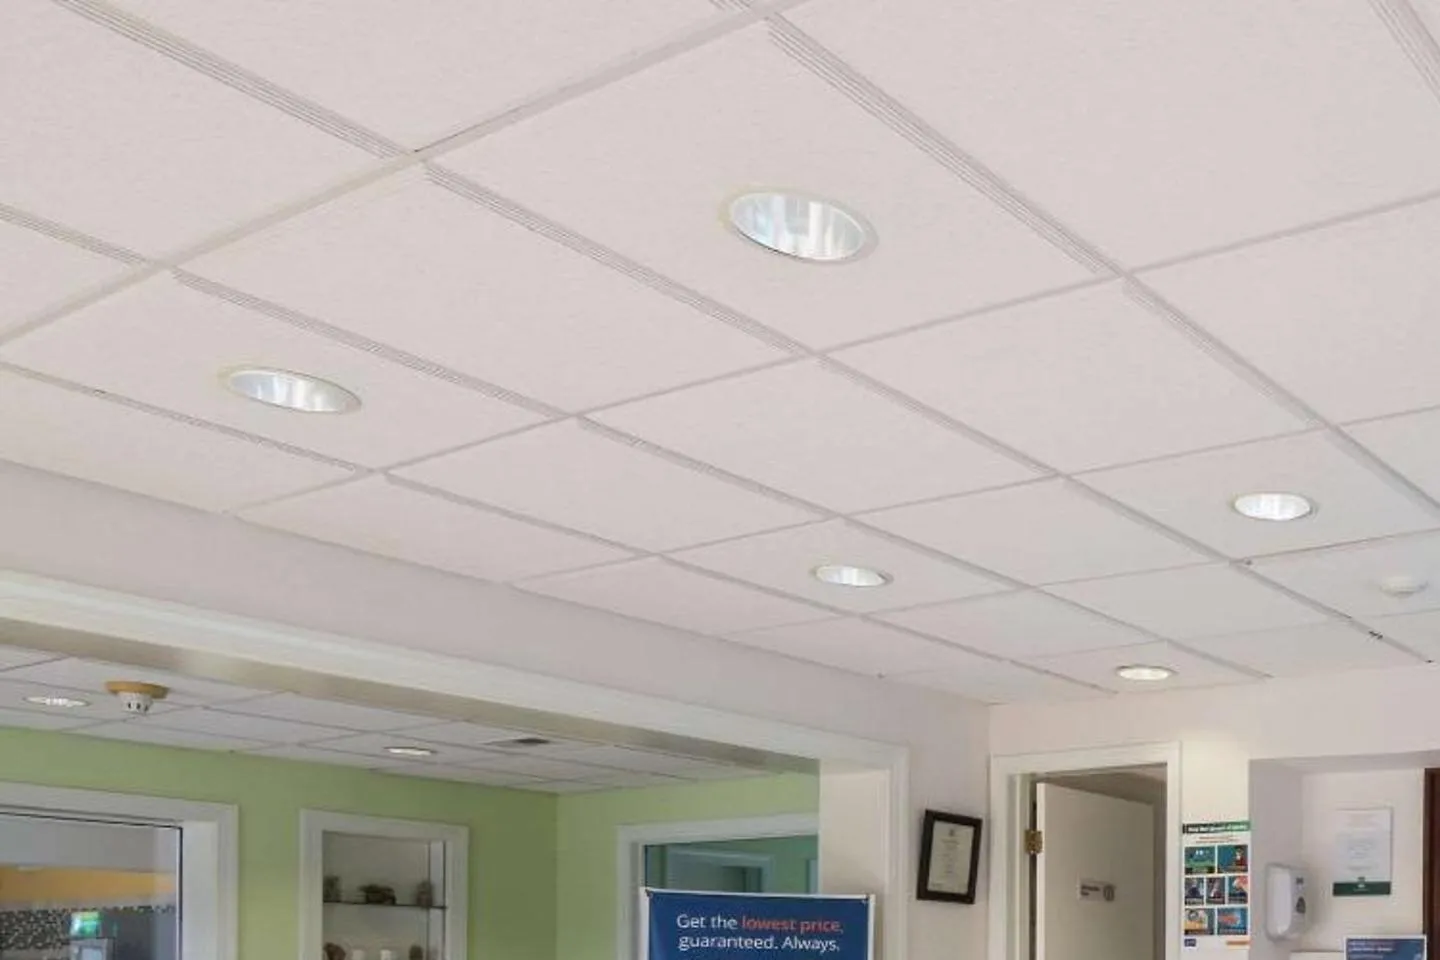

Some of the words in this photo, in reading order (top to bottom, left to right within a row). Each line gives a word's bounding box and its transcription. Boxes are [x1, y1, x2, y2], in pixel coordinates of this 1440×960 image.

[676, 914, 706, 929] Get
[710, 914, 738, 930] the
[742, 915, 796, 931] lowest
[799, 918, 844, 935] price,
[678, 936, 779, 951] guaranteed.
